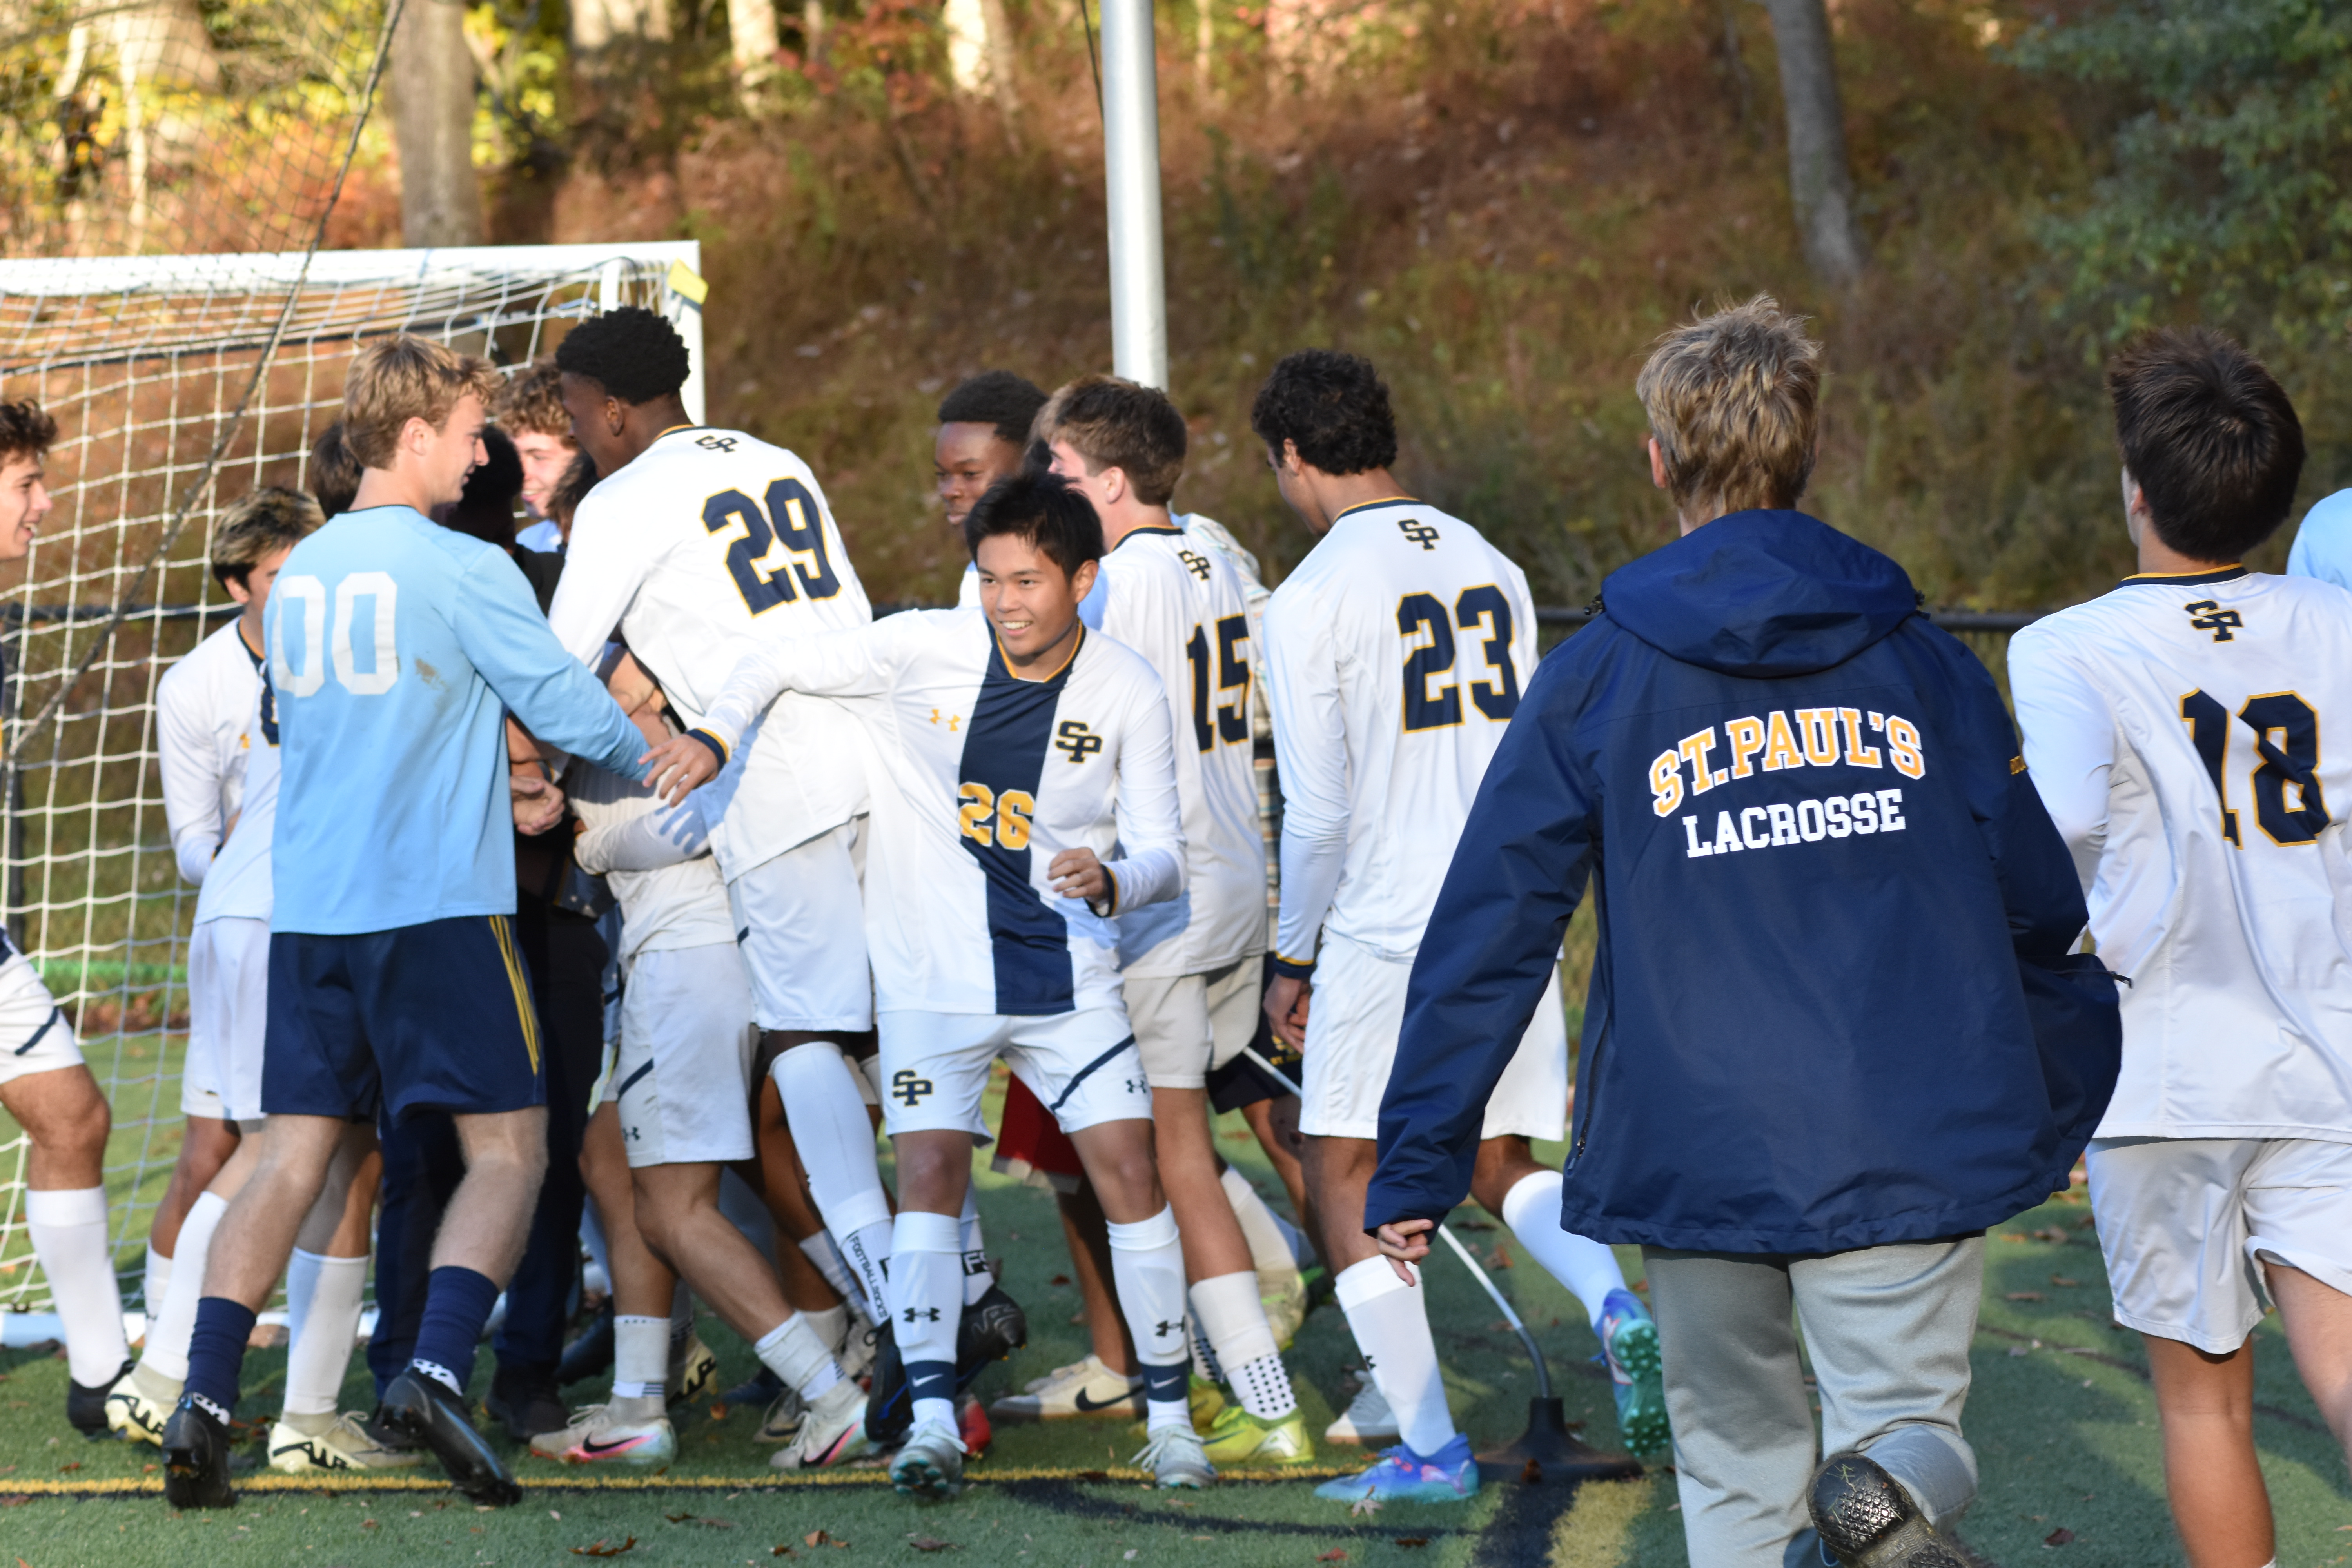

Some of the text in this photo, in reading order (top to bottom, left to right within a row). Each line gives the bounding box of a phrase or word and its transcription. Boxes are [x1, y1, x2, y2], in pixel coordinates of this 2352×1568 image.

[700, 475, 842, 619] 29
[269, 571, 398, 698] 00
[1396, 583, 1520, 735] 23
[2185, 599, 2244, 643] SP
[1187, 613, 1254, 754] 15
[1055, 720, 1103, 763] SP
[2180, 690, 2332, 850] 18
[957, 781, 1034, 850] 26
[1682, 789, 1906, 858] LACROSSE
[892, 1069, 933, 1107] SP
